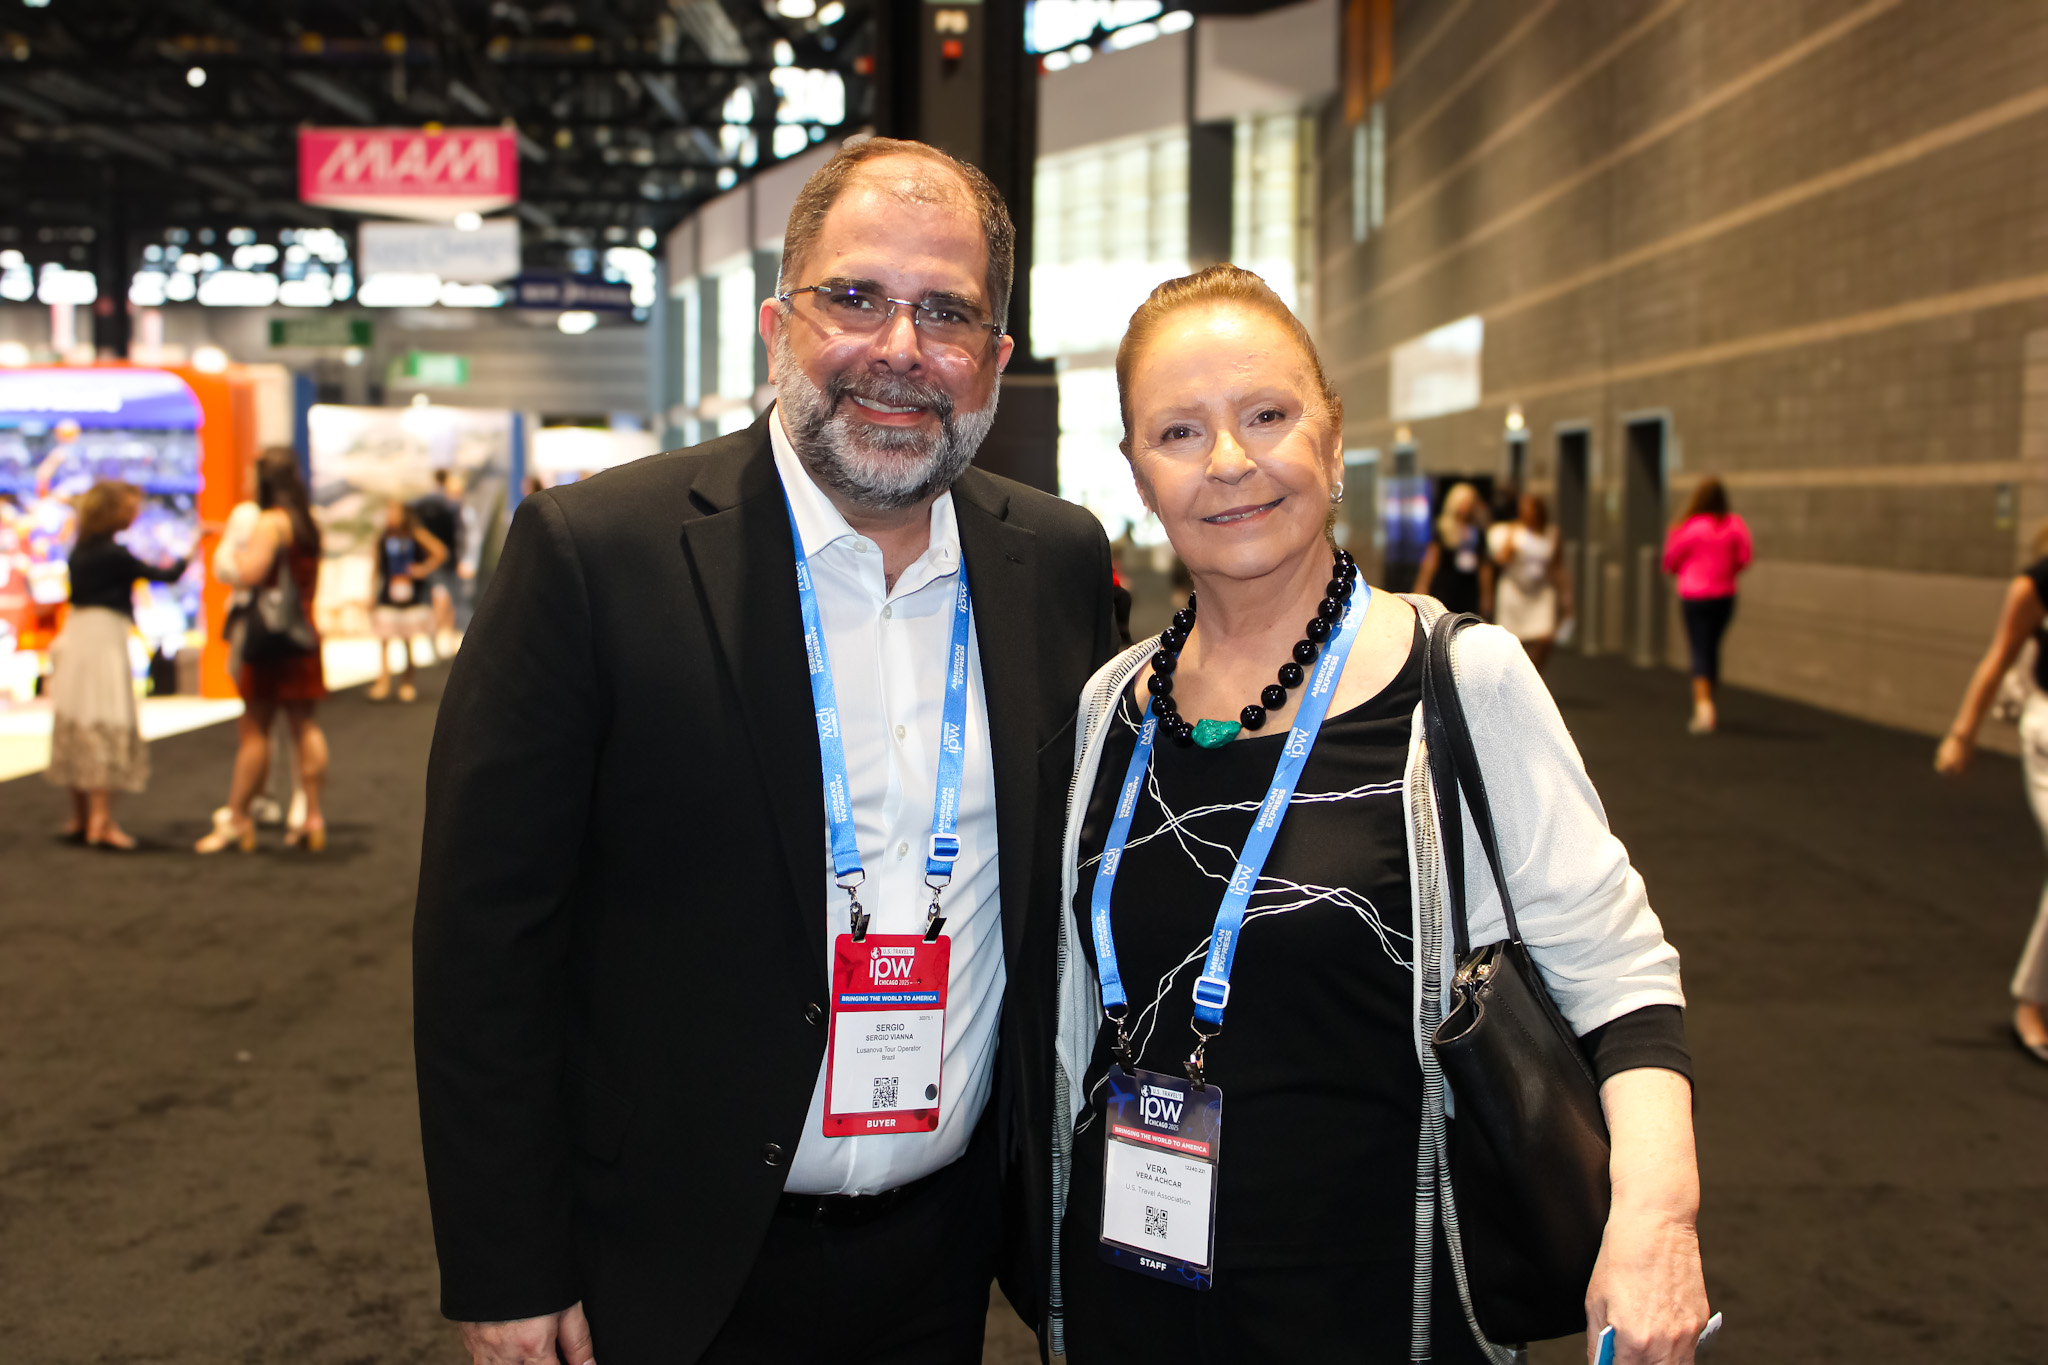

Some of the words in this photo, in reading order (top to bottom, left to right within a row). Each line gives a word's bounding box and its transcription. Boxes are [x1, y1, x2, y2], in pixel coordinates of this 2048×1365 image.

[805, 634, 817, 676] EXPRESS
[810, 626, 825, 673] AMERICAN
[951, 644, 961, 690] AMERICAN
[1311, 654, 1332, 698] AMERICAN
[1320, 655, 1340, 694] EXPRESS
[816, 707, 834, 740] ipw
[948, 723, 962, 754] ipw
[1140, 718, 1152, 746] ipw
[1290, 728, 1310, 758] ipw
[829, 782, 842, 824] EXPRESS
[835, 774, 848, 822] AMERICAN
[938, 787, 948, 834] AMERICAN
[945, 788, 955, 828] EXPRESS
[1118, 782, 1134, 819] EXPRESS
[1124, 776, 1140, 818] AMERICAN
[1256, 788, 1279, 832] AMERICAN
[1264, 789, 1286, 828] EXPRESS
[1101, 847, 1116, 876] ipw
[1234, 865, 1255, 896] ipw
[1096, 916, 1107, 958] EXPRESS
[1100, 908, 1112, 958] AMERICAN
[1208, 929, 1226, 978] AMERICAN
[1218, 930, 1232, 972] EXPRESS
[869, 956, 914, 986] ipw
[842, 994, 870, 1002] BRINGING
[876, 1024, 905, 1032] SERGIO
[897, 1045, 922, 1053] Operator
[866, 1119, 896, 1128] BUYER
[1140, 1094, 1184, 1124] ipw
[1149, 1119, 1168, 1128] CHICAGO
[1114, 1126, 1140, 1138] BRINGING
[1152, 1136, 1172, 1145] WORLD
[1181, 1142, 1207, 1153] AMERICA
[1136, 1171, 1153, 1181] VERA
[1154, 1176, 1182, 1189] ACHCAR
[1146, 1163, 1168, 1175] VERA
[1125, 1183, 1136, 1192] U.S.
[1138, 1186, 1156, 1197] Travel
[1157, 1192, 1192, 1206] Association
[1140, 1257, 1167, 1271] STAFF
